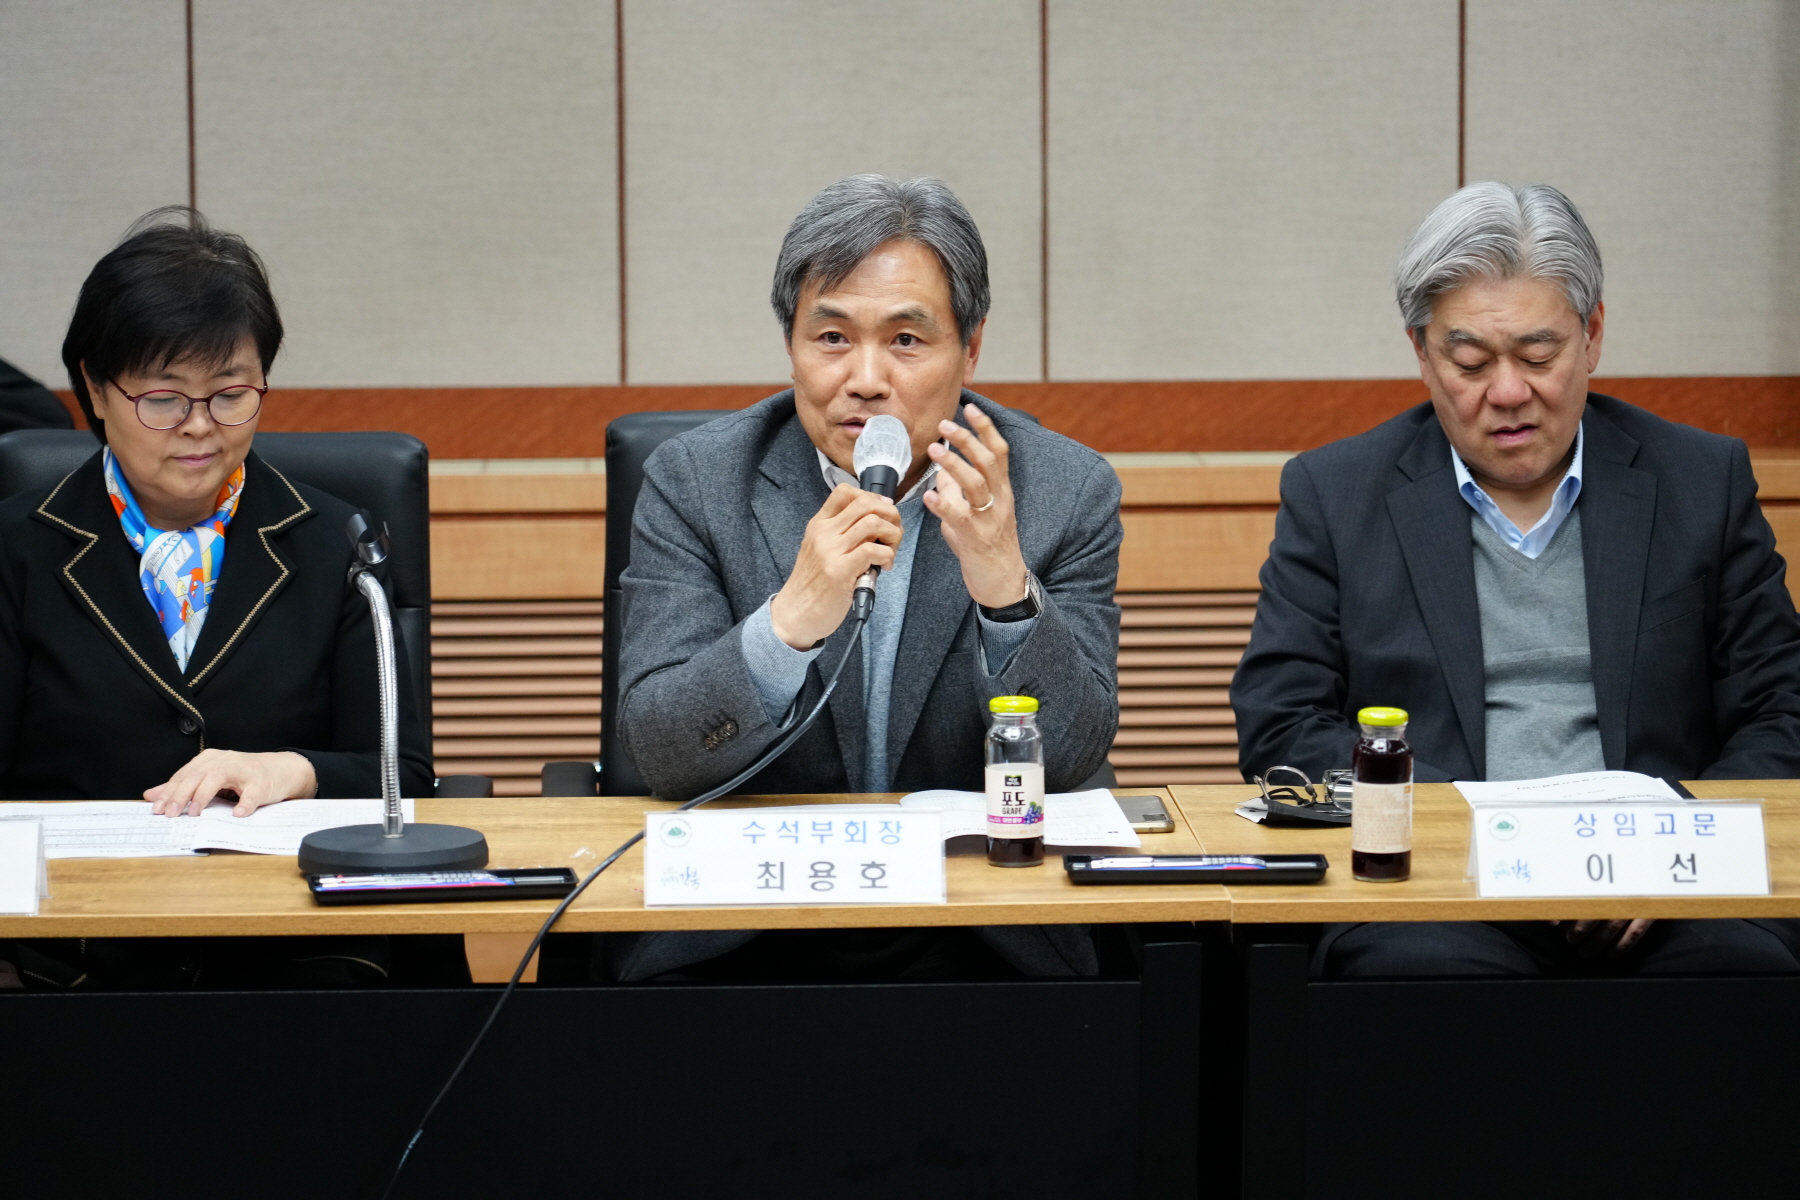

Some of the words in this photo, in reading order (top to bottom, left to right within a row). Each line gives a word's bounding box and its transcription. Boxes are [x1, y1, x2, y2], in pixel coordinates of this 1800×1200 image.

[1002, 791, 1026, 806] 포도
[1002, 807, 1022, 815] GRAPE
[742, 820, 903, 845] 수석부회장
[1573, 812, 1716, 837] 상임고문
[756, 860, 889, 892] 최용호
